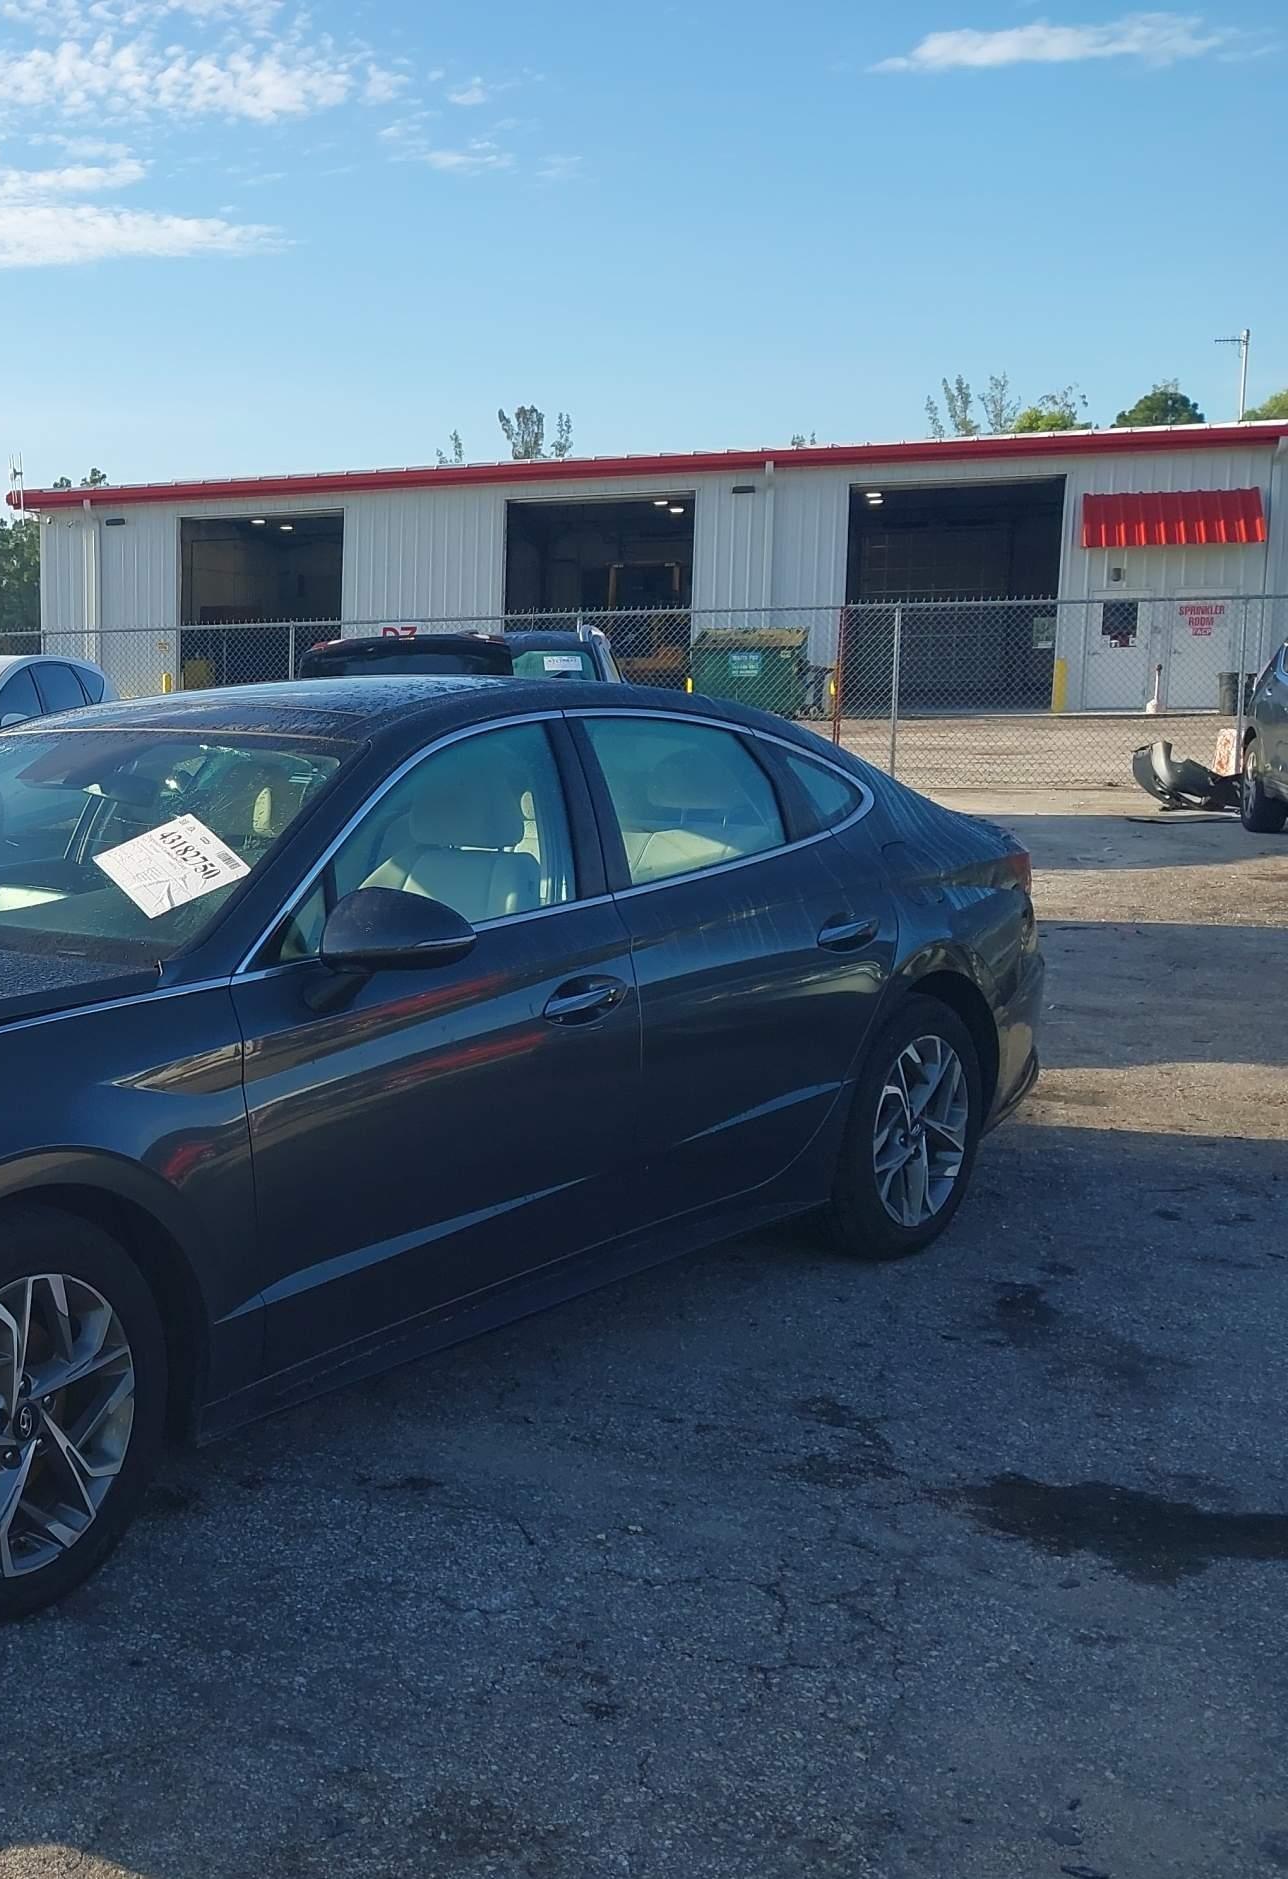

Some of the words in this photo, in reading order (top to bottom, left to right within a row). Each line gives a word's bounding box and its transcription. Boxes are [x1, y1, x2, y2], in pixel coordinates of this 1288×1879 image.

[1178, 604, 1225, 616] SPRINKLER
[1188, 616, 1215, 627] ROOM
[158, 831, 222, 881] 43182750
